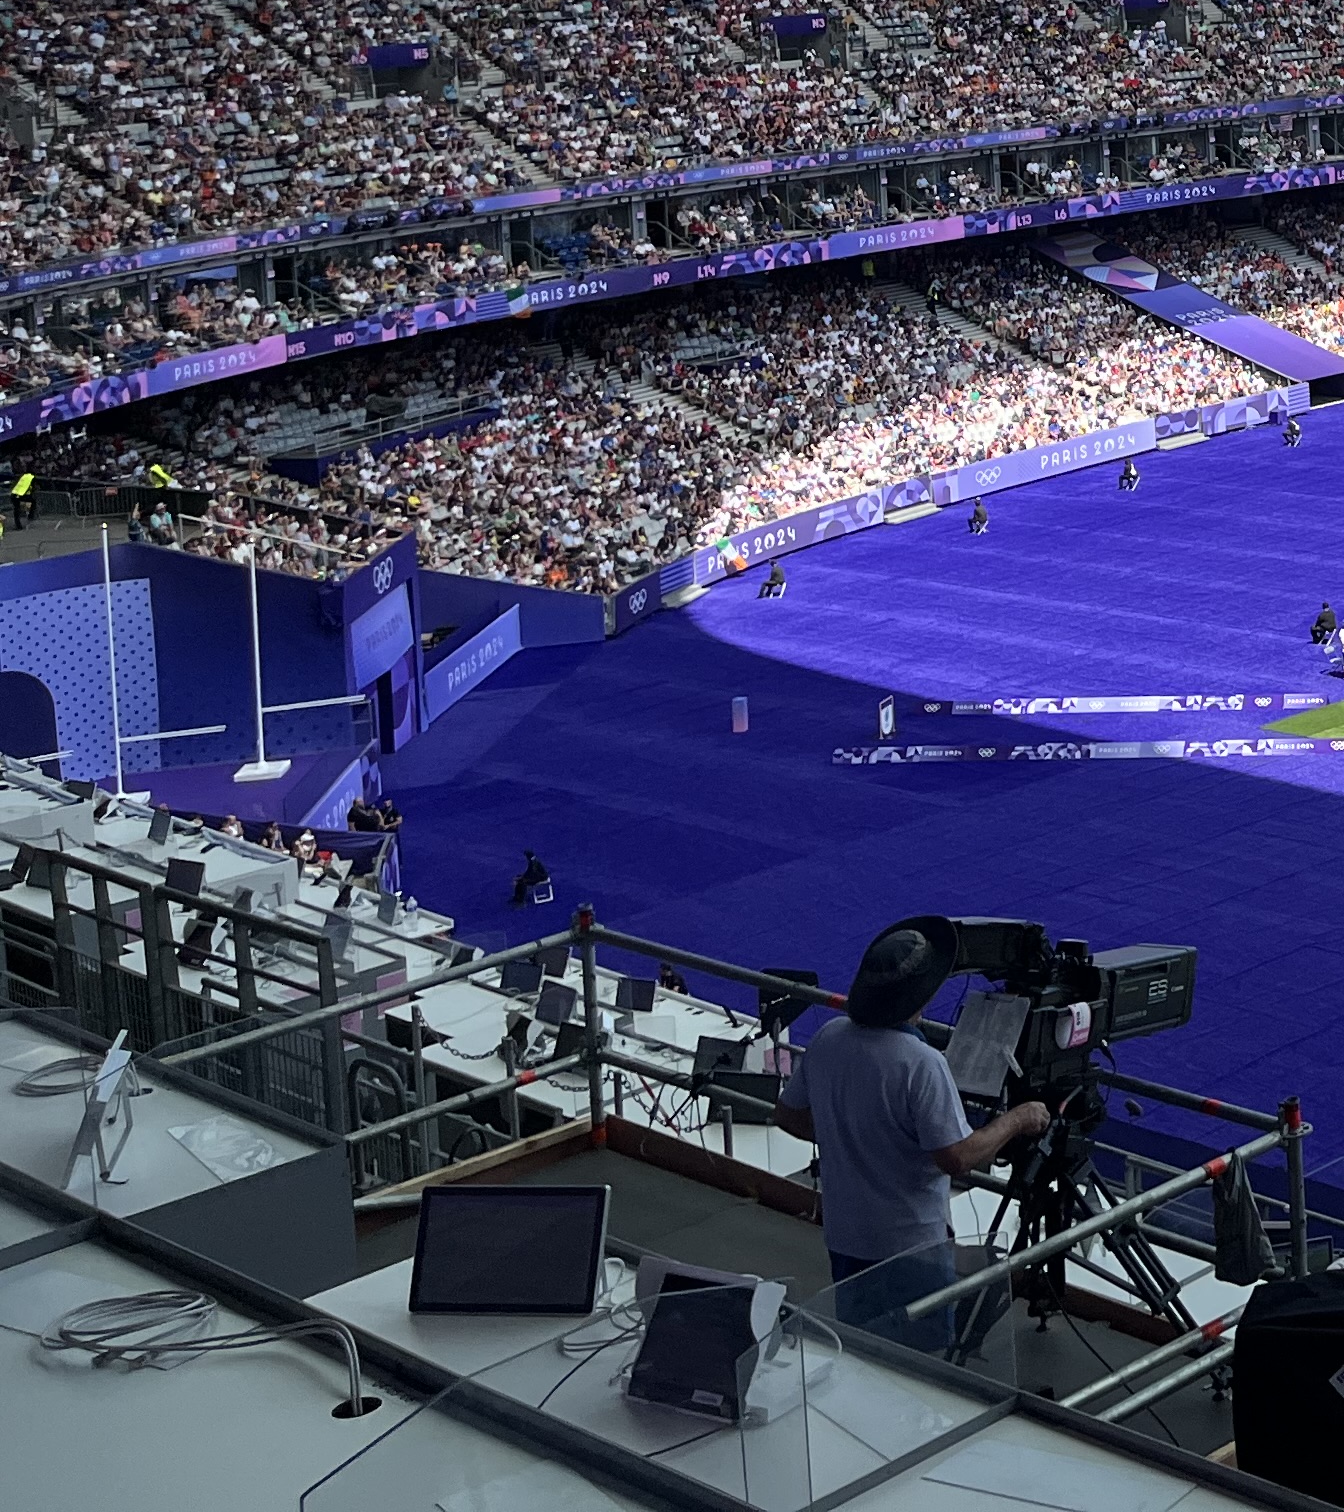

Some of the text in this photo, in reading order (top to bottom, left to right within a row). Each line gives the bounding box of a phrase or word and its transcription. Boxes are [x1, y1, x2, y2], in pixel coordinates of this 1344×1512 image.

[1185, 186, 1216, 199] 2024
[901, 228, 934, 244] 2024
[569, 280, 608, 298] 2024
[220, 351, 256, 370] 2024
[1041, 433, 1135, 469] PARIS 2024
[708, 526, 796, 573] PAIS 2024
[448, 636, 504, 692] PARIS 2024
